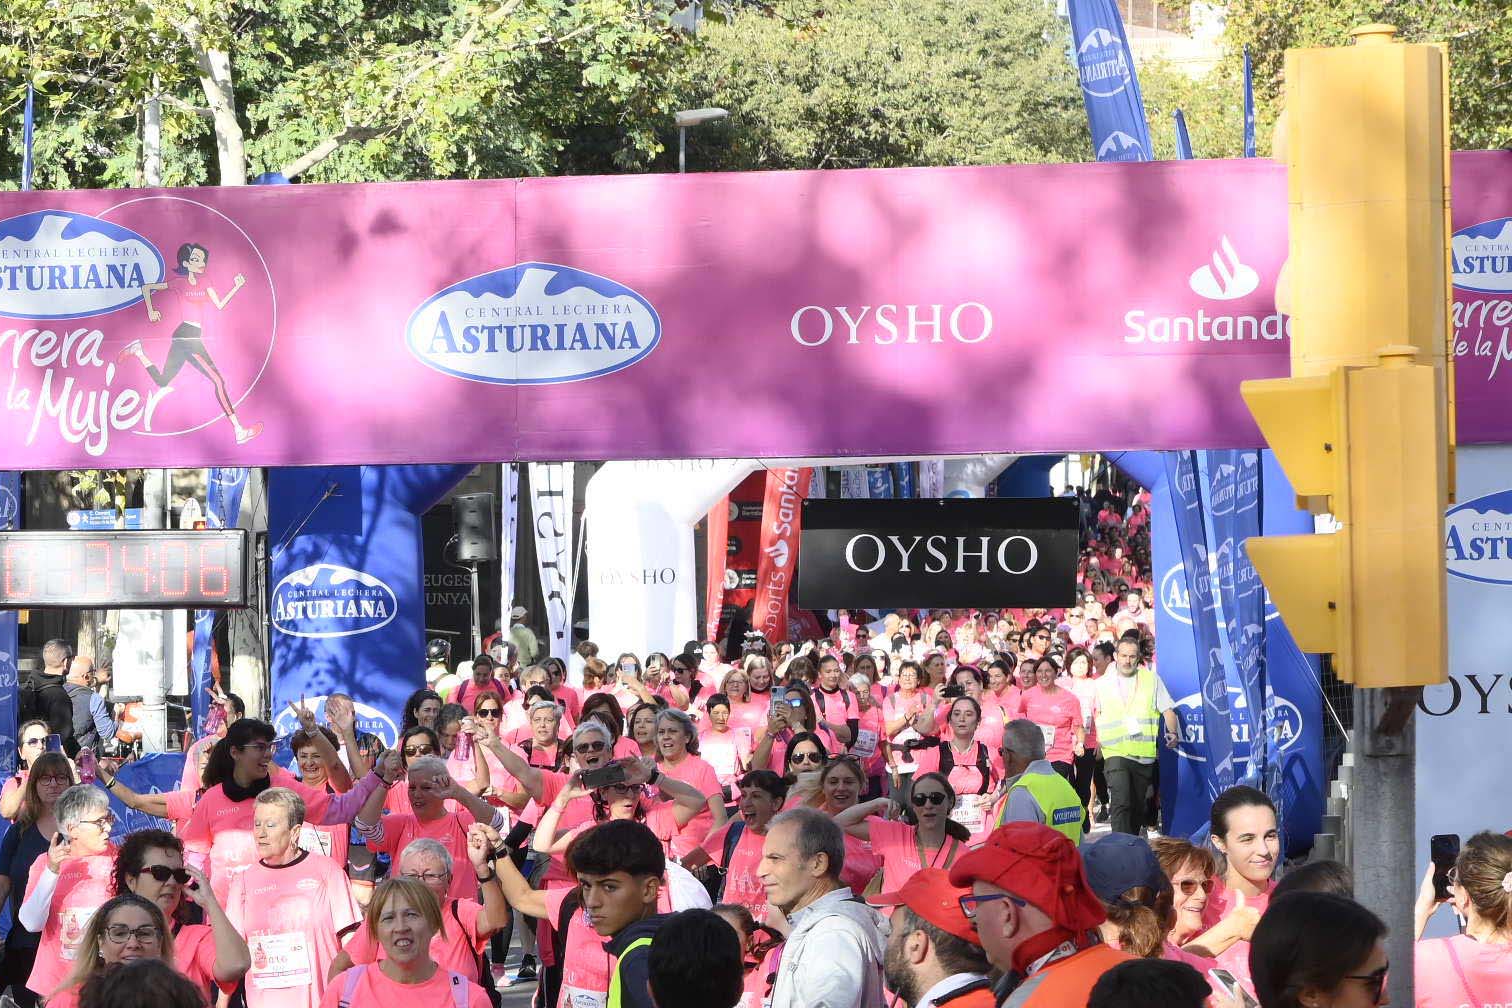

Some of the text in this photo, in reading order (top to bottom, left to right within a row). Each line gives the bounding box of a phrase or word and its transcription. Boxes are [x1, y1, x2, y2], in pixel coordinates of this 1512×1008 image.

[66, 246, 140, 258] LECHERA
[465, 302, 633, 319] CENTRAL LECHERA
[791, 302, 994, 347] OYSHO
[427, 309, 641, 355] ASTURIANA
[1123, 310, 1292, 343] Santand
[7, 367, 30, 411] la
[25, 363, 175, 457] Mujer
[844, 533, 1038, 575] OYSHO
[276, 593, 388, 622] ASTURIANA
[288, 588, 383, 599] CENTRAL LECHERA
[426, 592, 471, 605] UNYA
